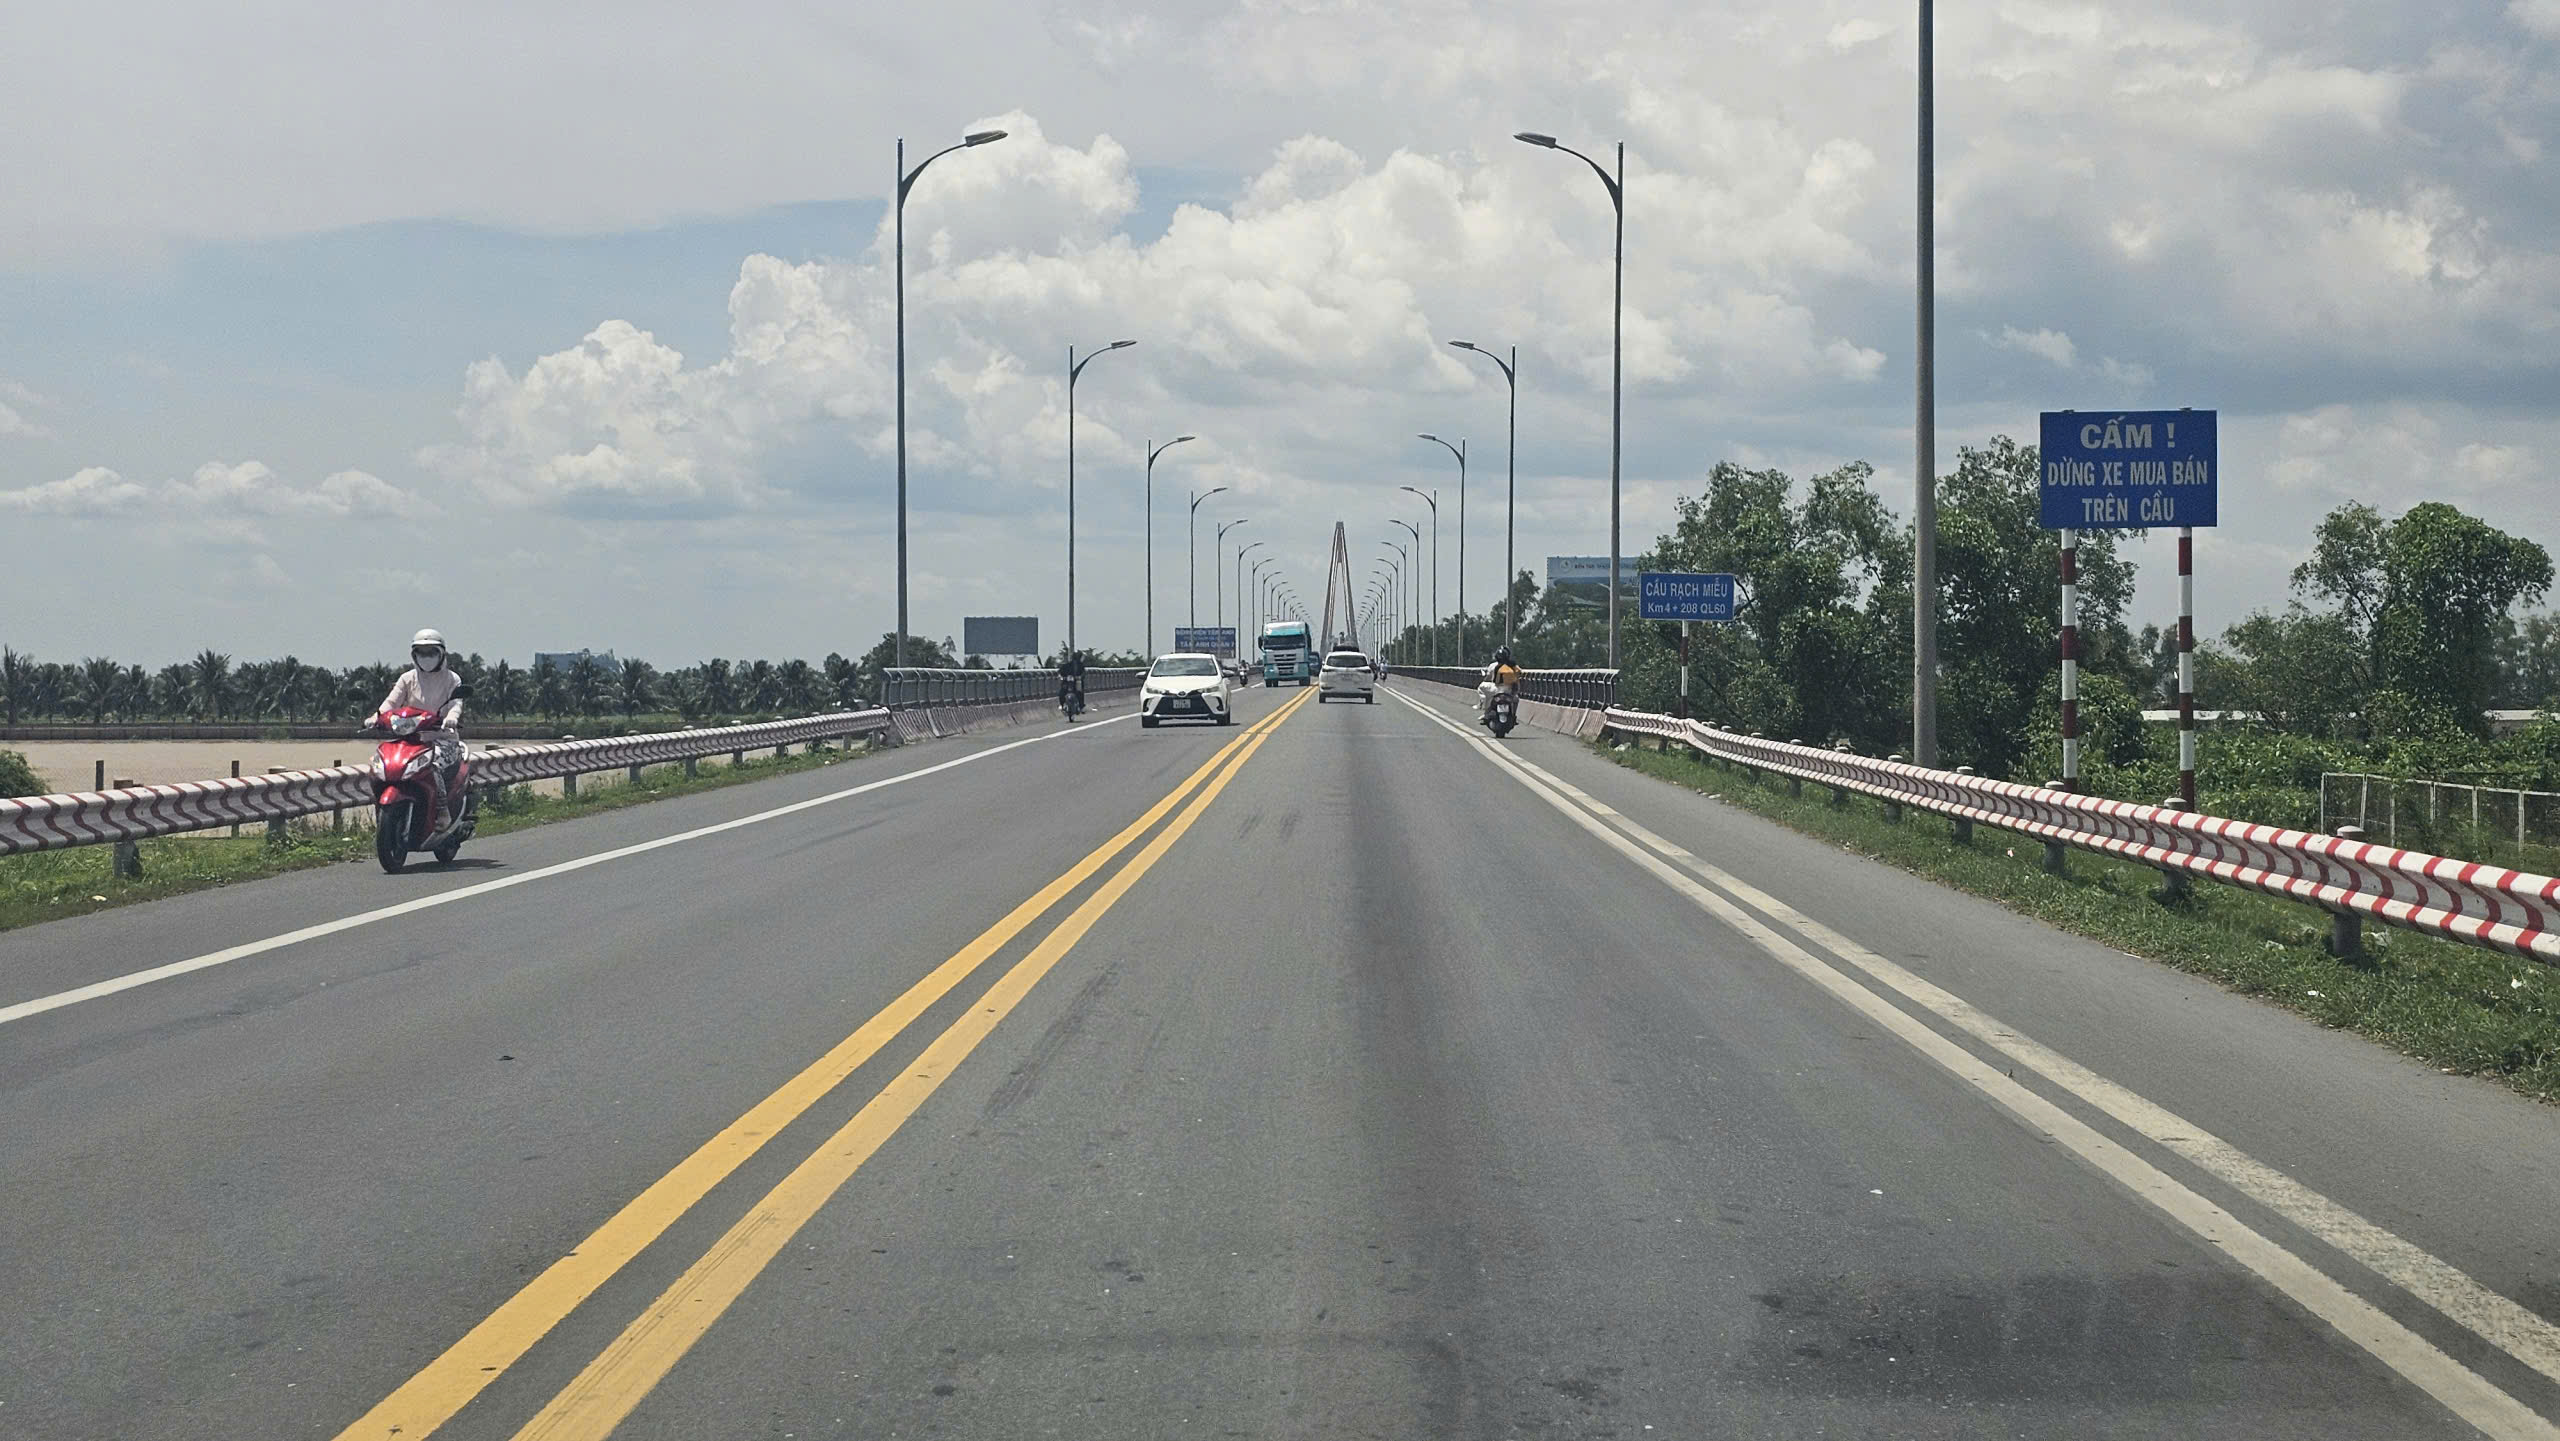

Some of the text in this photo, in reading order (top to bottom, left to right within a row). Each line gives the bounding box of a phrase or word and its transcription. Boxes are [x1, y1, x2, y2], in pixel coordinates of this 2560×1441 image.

[2080, 415, 2152, 449] CẤM
[2047, 454, 2208, 486] DỪNG XE MUA BÁN
[2082, 489, 2174, 522] TRÊN CẦU
[1670, 583, 1699, 600] RẠCH
[1700, 603, 1726, 614] QL60
